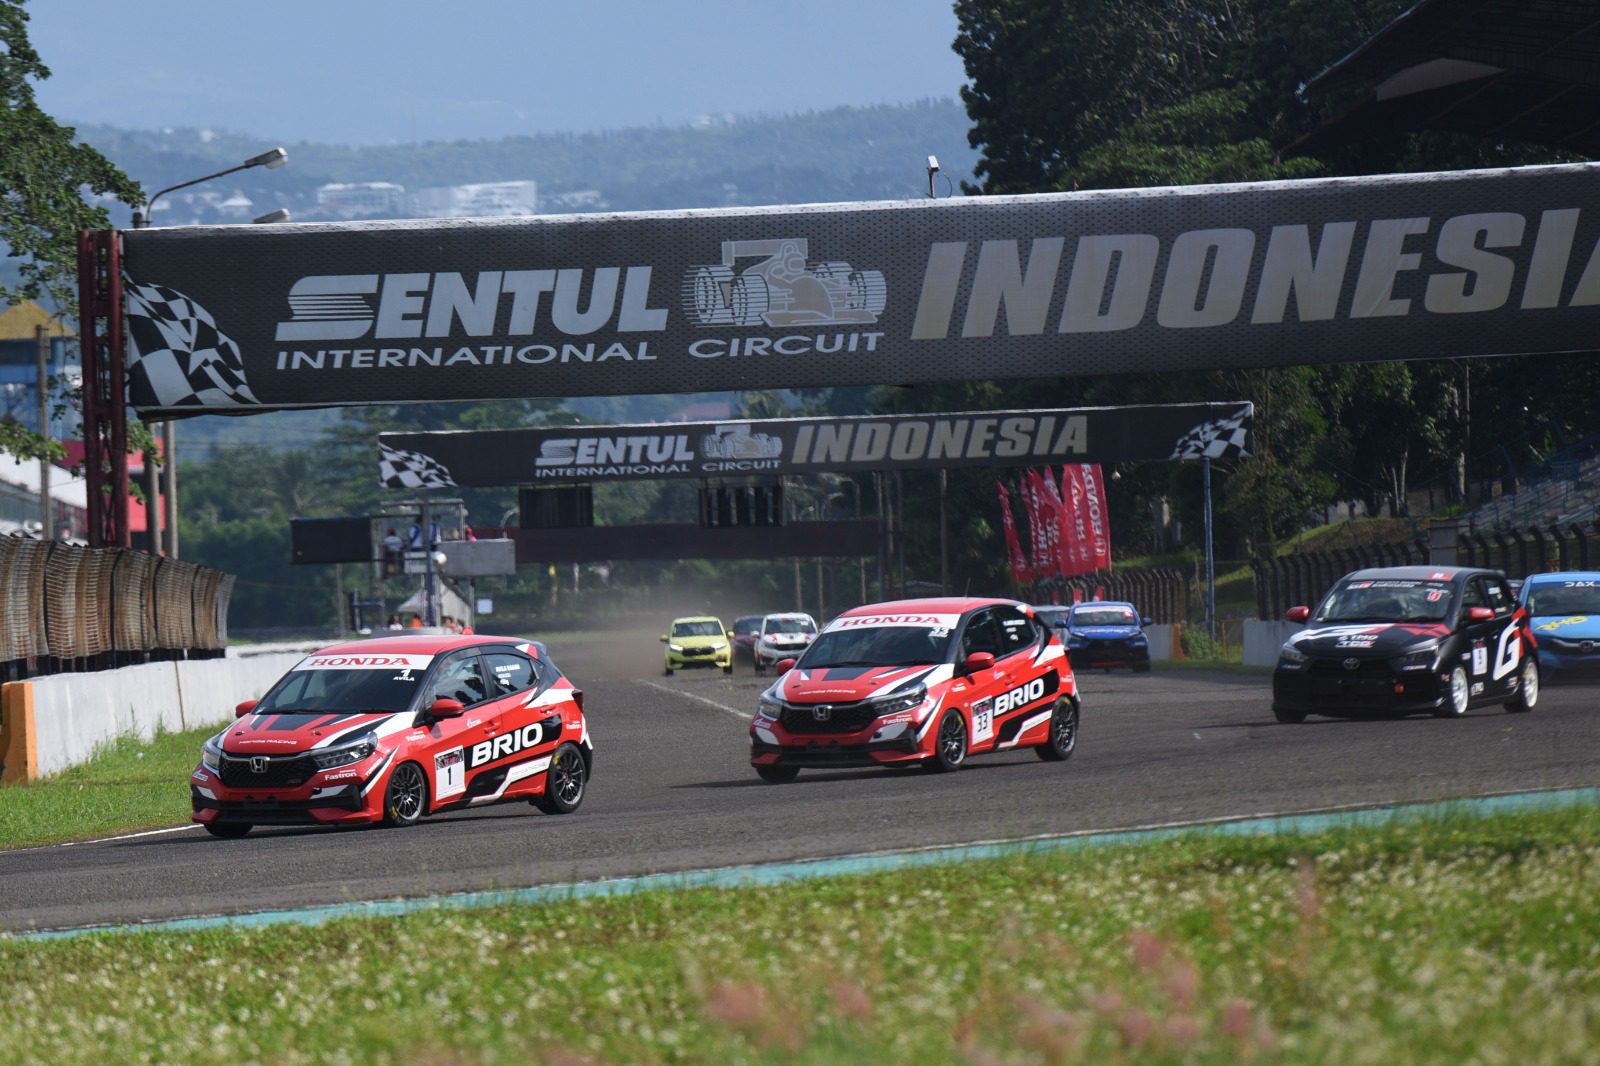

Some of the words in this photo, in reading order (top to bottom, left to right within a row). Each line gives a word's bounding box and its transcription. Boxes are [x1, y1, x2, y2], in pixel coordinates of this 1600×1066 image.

[274, 265, 669, 342] SENTUL
[276, 341, 658, 371] INTERNATIONAL
[688, 331, 885, 359] CIRCUIT
[535, 435, 694, 467] SENTUL
[791, 415, 1088, 465] INDONESIA
[535, 463, 690, 478] INTERNATIONAL
[702, 460, 781, 472] CIRCUIT
[840, 616, 941, 627] HONDA
[308, 657, 411, 667] HONDA
[993, 677, 1044, 718] BRIO
[977, 712, 988, 733] 33
[471, 722, 543, 767] BRIO
[324, 771, 357, 781] Fastron
[447, 766, 452, 786] 1
